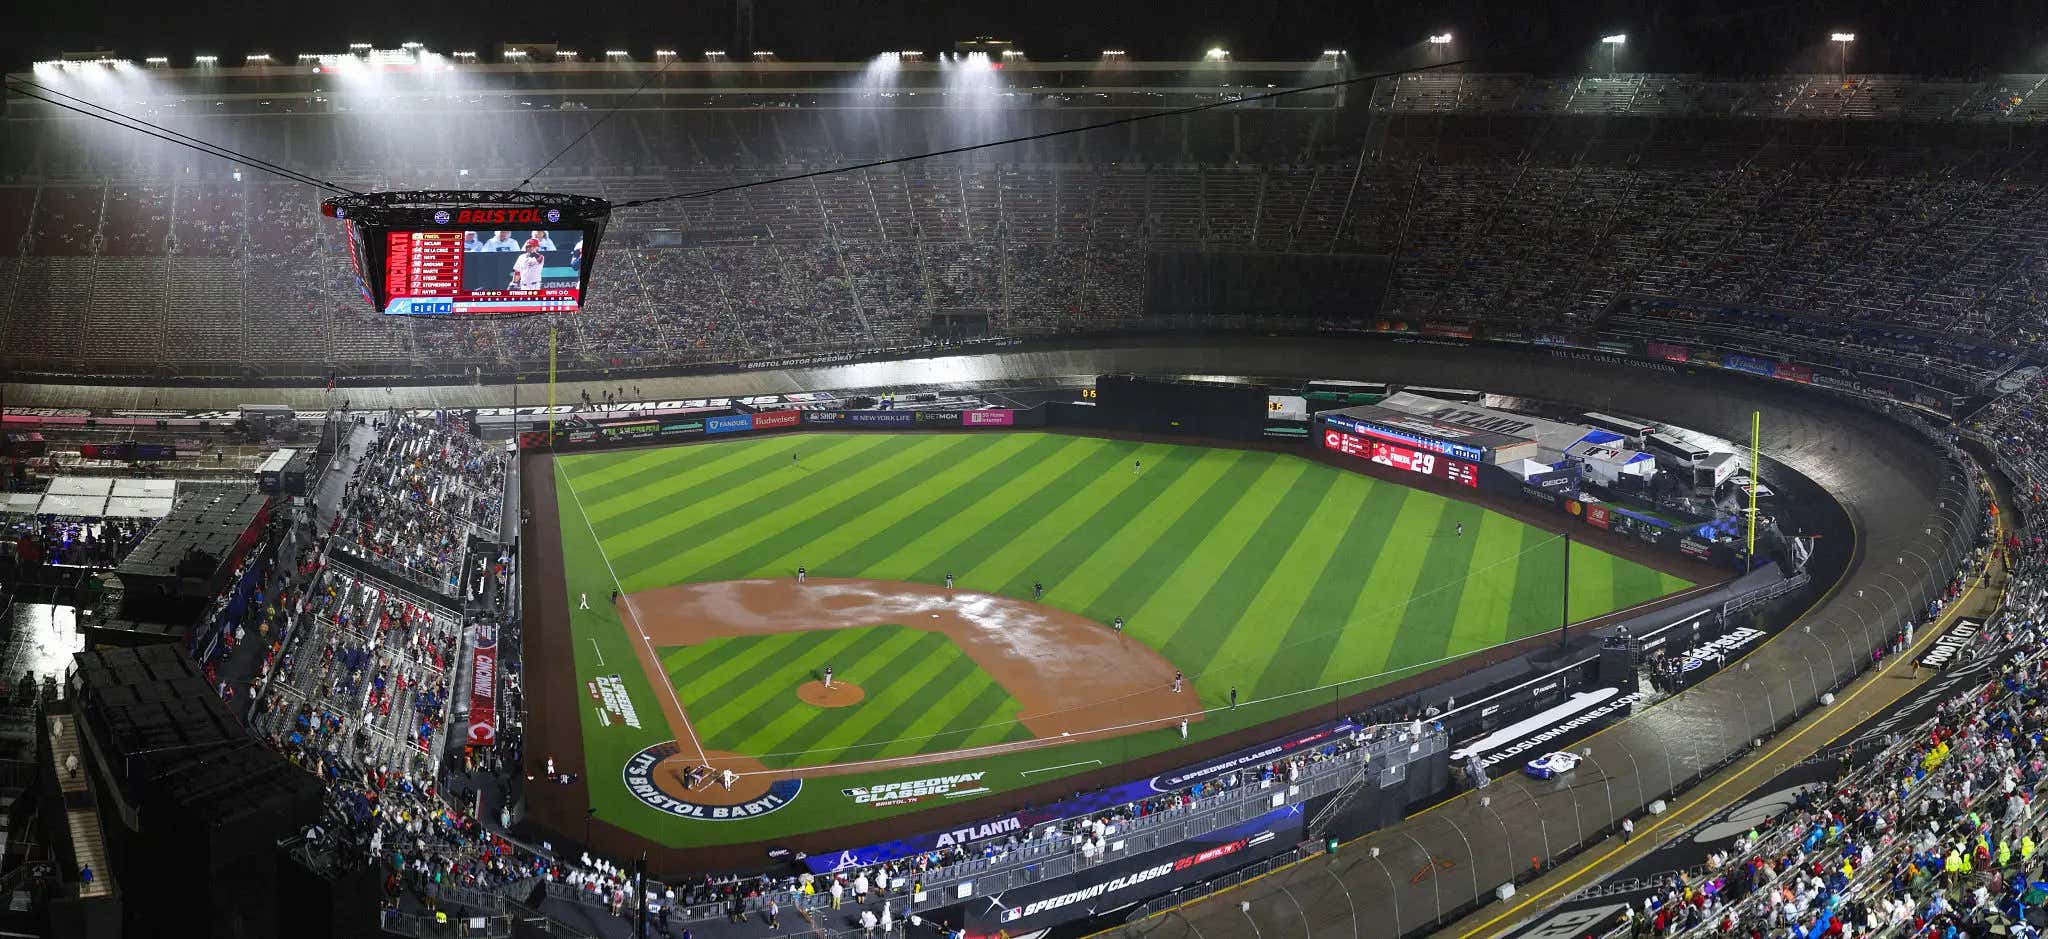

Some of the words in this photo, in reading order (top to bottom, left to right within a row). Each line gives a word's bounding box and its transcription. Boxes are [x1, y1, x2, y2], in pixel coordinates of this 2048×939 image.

[457, 209, 542, 224] BRISTOL
[390, 233, 408, 295] CINCINNATI
[748, 360, 780, 369] BRISTOL
[812, 353, 855, 364] SPEEDWAY
[719, 419, 749, 428] FANDUEL
[755, 416, 796, 426] Budweiser
[820, 412, 837, 421] SHOP
[926, 412, 957, 420] BETMGM
[1411, 452, 1435, 475] 29
[1542, 477, 1568, 487] GEICO
[1681, 626, 1760, 659] Bristol
[475, 655, 492, 698] CINCINNATI
[628, 753, 657, 776] IT'S
[1182, 759, 1238, 781] SPEEDWAY
[1238, 746, 1283, 764] CLASSIC
[855, 784, 950, 804] CLASSIC
[871, 771, 987, 794] SPEEDWAY
[629, 776, 705, 817] BRISTOL
[712, 794, 784, 818] BABY!
[935, 817, 1021, 848] ATLANTA
[1023, 882, 1109, 917] SPEEDWAY
[1107, 862, 1174, 893] CLASSIC
[1173, 856, 1193, 872] '25
